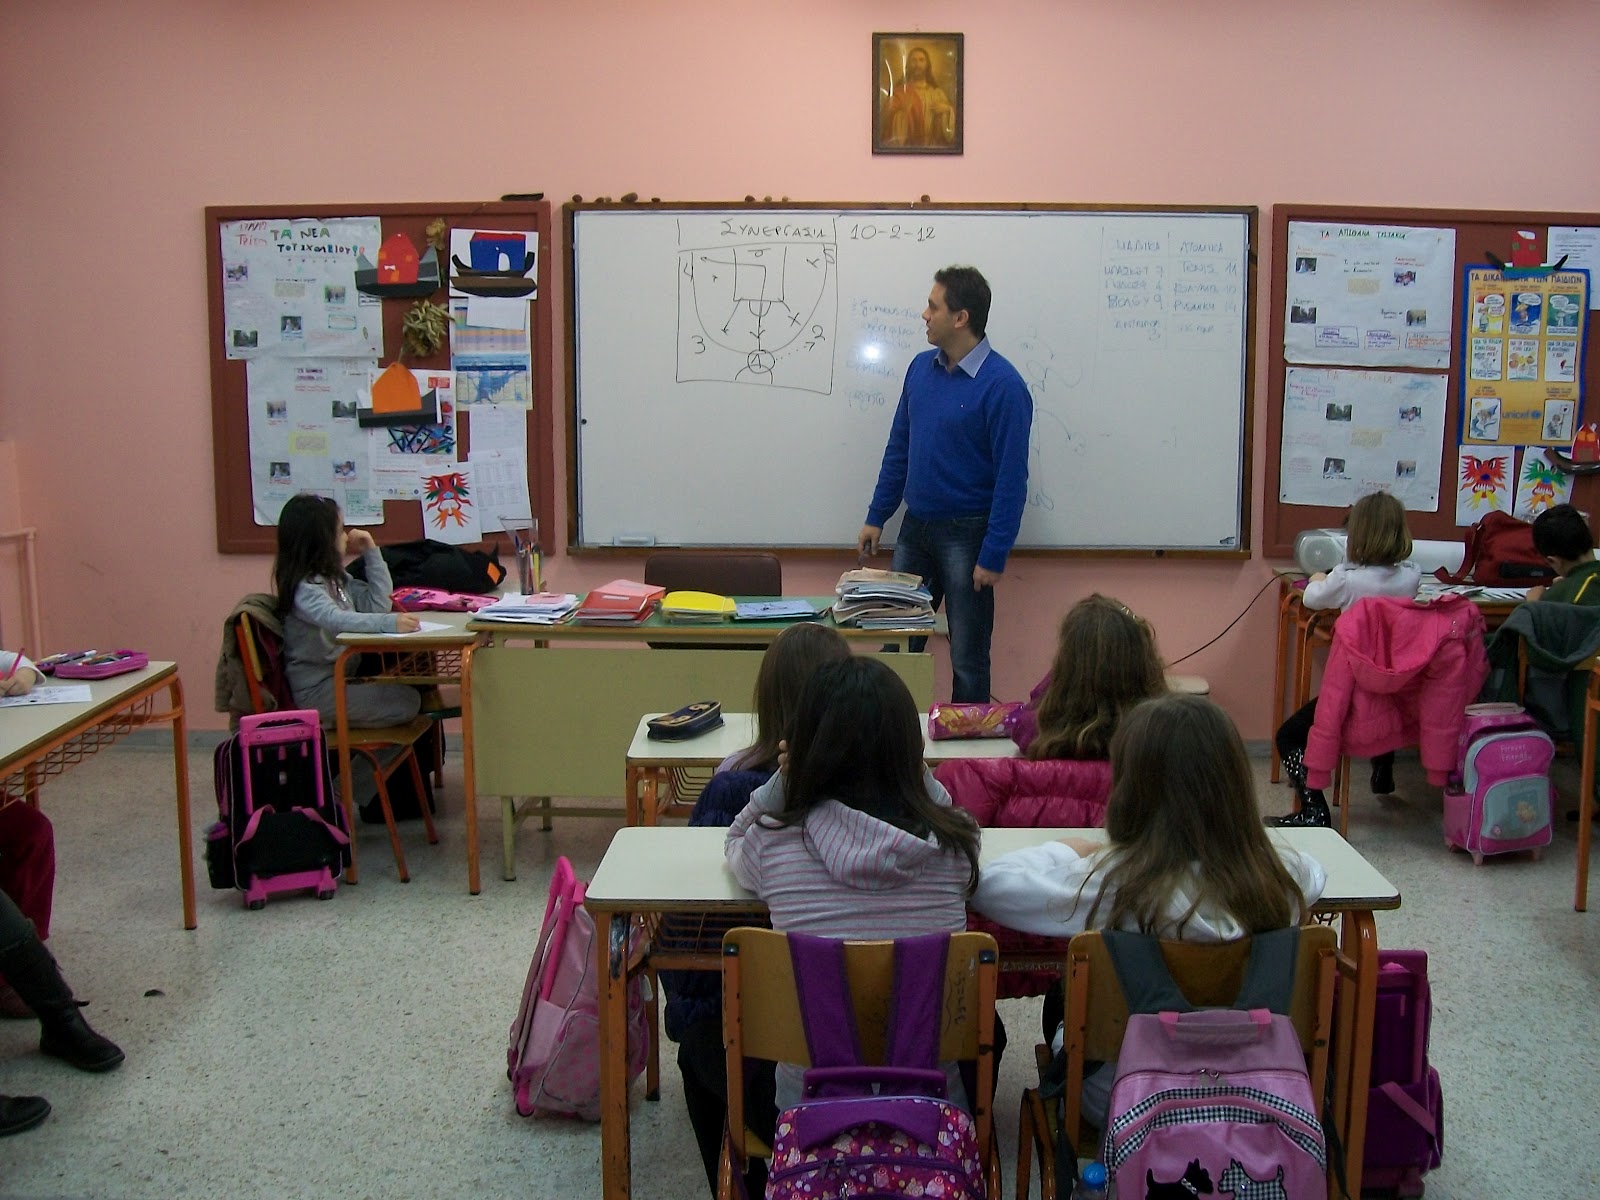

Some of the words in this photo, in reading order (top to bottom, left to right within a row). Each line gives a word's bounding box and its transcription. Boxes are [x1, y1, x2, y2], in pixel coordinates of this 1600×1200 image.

[270, 228, 292, 241] ΤΑ
[300, 227, 330, 239] ΝΕΑ
[850, 223, 936, 242] 10-2-12
[1471, 273, 1480, 281] ΤΑ
[1552, 275, 1582, 283] ΠΑΙΔΙΩΝ
[691, 334, 706, 354] 3
